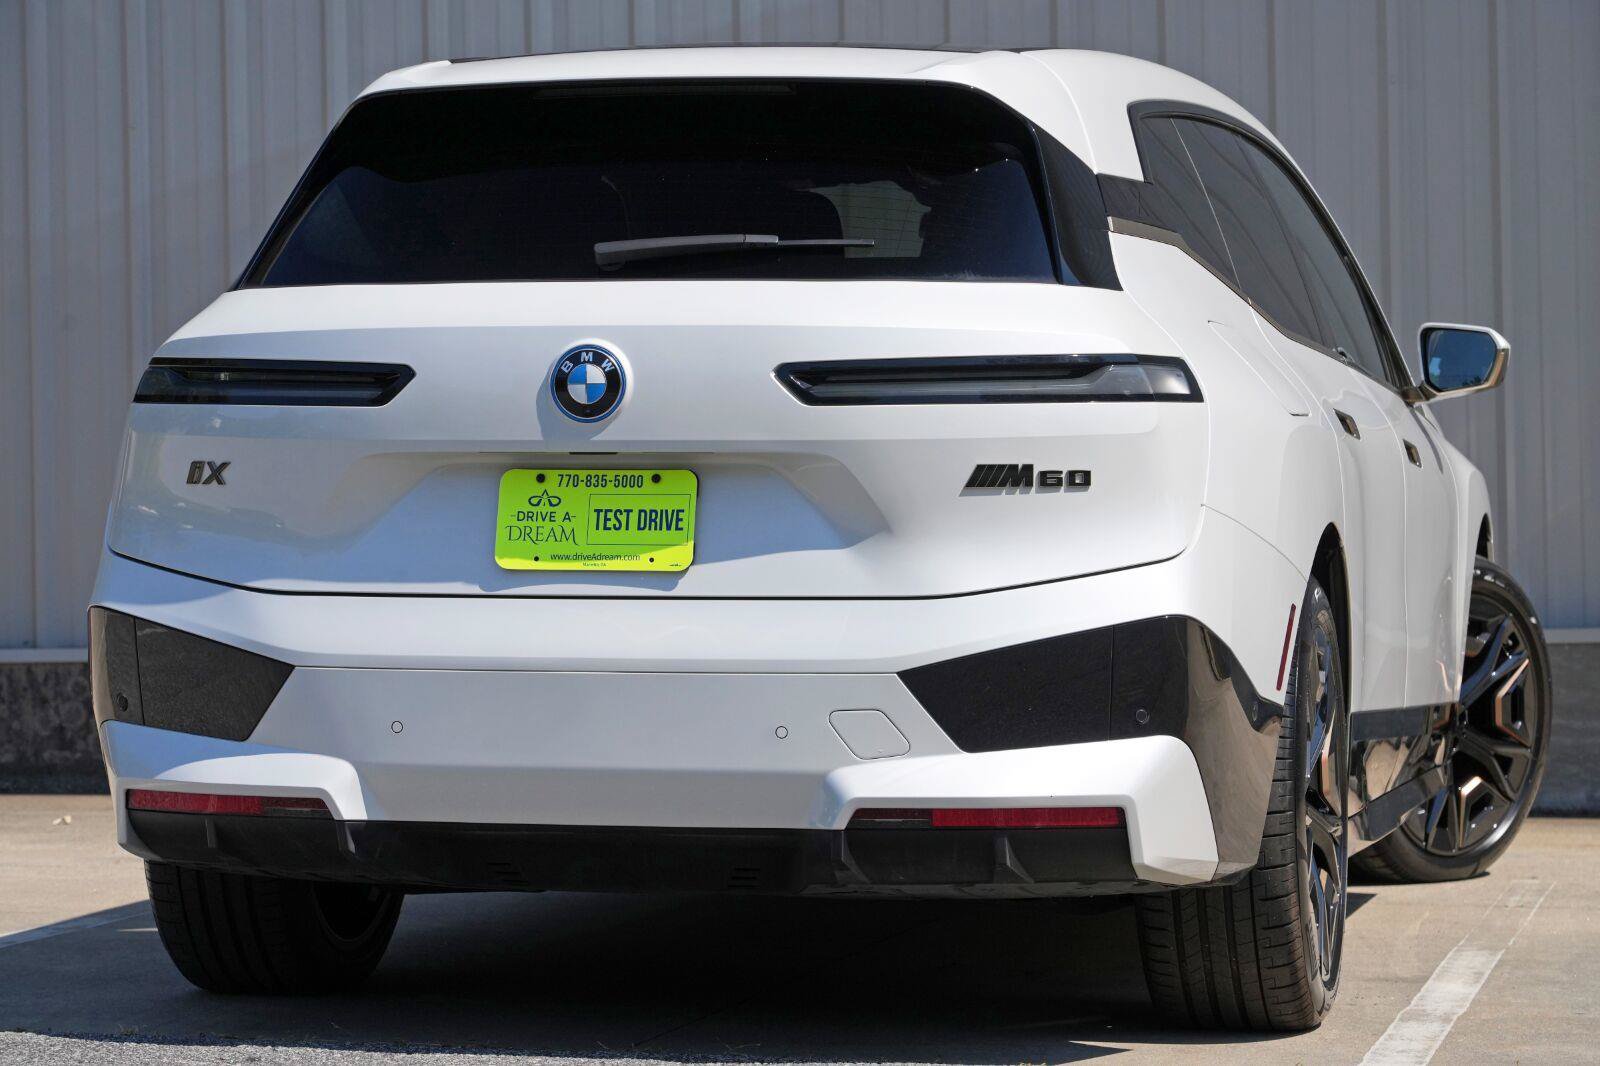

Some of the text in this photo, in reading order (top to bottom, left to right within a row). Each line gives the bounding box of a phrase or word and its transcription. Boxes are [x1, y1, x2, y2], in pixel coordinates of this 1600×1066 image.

[561, 351, 615, 373] BMW
[557, 474, 644, 488] 770-835-5000
[516, 510, 556, 522] DRIVE
[594, 508, 685, 531] TEST DRIVE
[505, 525, 580, 546] DREAM
[550, 552, 641, 562] www.driveAdream.com
